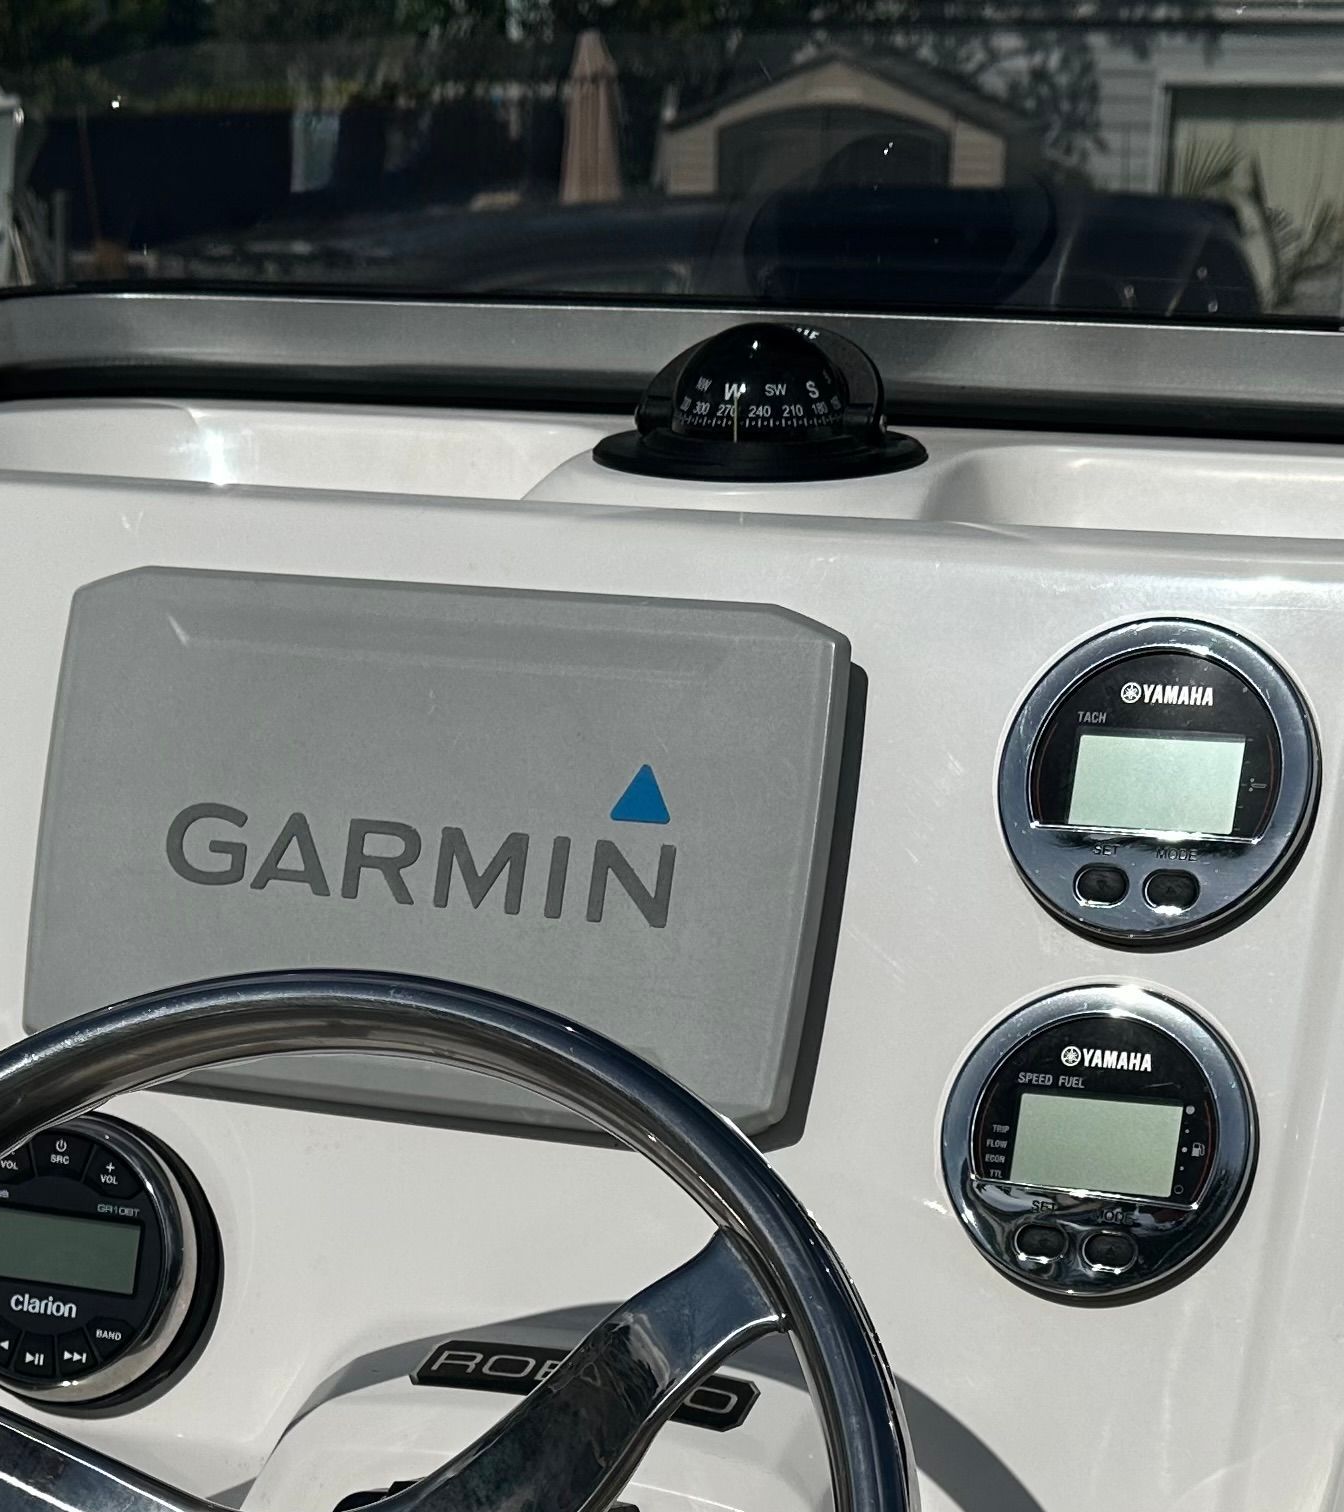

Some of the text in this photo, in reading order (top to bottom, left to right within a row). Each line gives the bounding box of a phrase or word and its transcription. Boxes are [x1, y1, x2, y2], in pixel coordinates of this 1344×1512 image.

[765, 383, 787, 397] SW
[806, 380, 820, 399] S
[716, 404, 736, 417] 270
[748, 405, 771, 418] 240
[782, 404, 804, 417] 210
[1142, 684, 1214, 706] YAMAHA
[1077, 711, 1106, 723] TACH
[1092, 844, 1120, 857] SET
[165, 802, 677, 929] GARMIN
[1082, 1048, 1152, 1072] YAMAHA
[1017, 1072, 1085, 1089] SPEED FUEL
[986, 1138, 1008, 1149] FLOW
[0, 1160, 19, 1171] VOL
[50, 1153, 70, 1165] SRC
[100, 1174, 118, 1185] VOL
[95, 1329, 122, 1341] BAND
